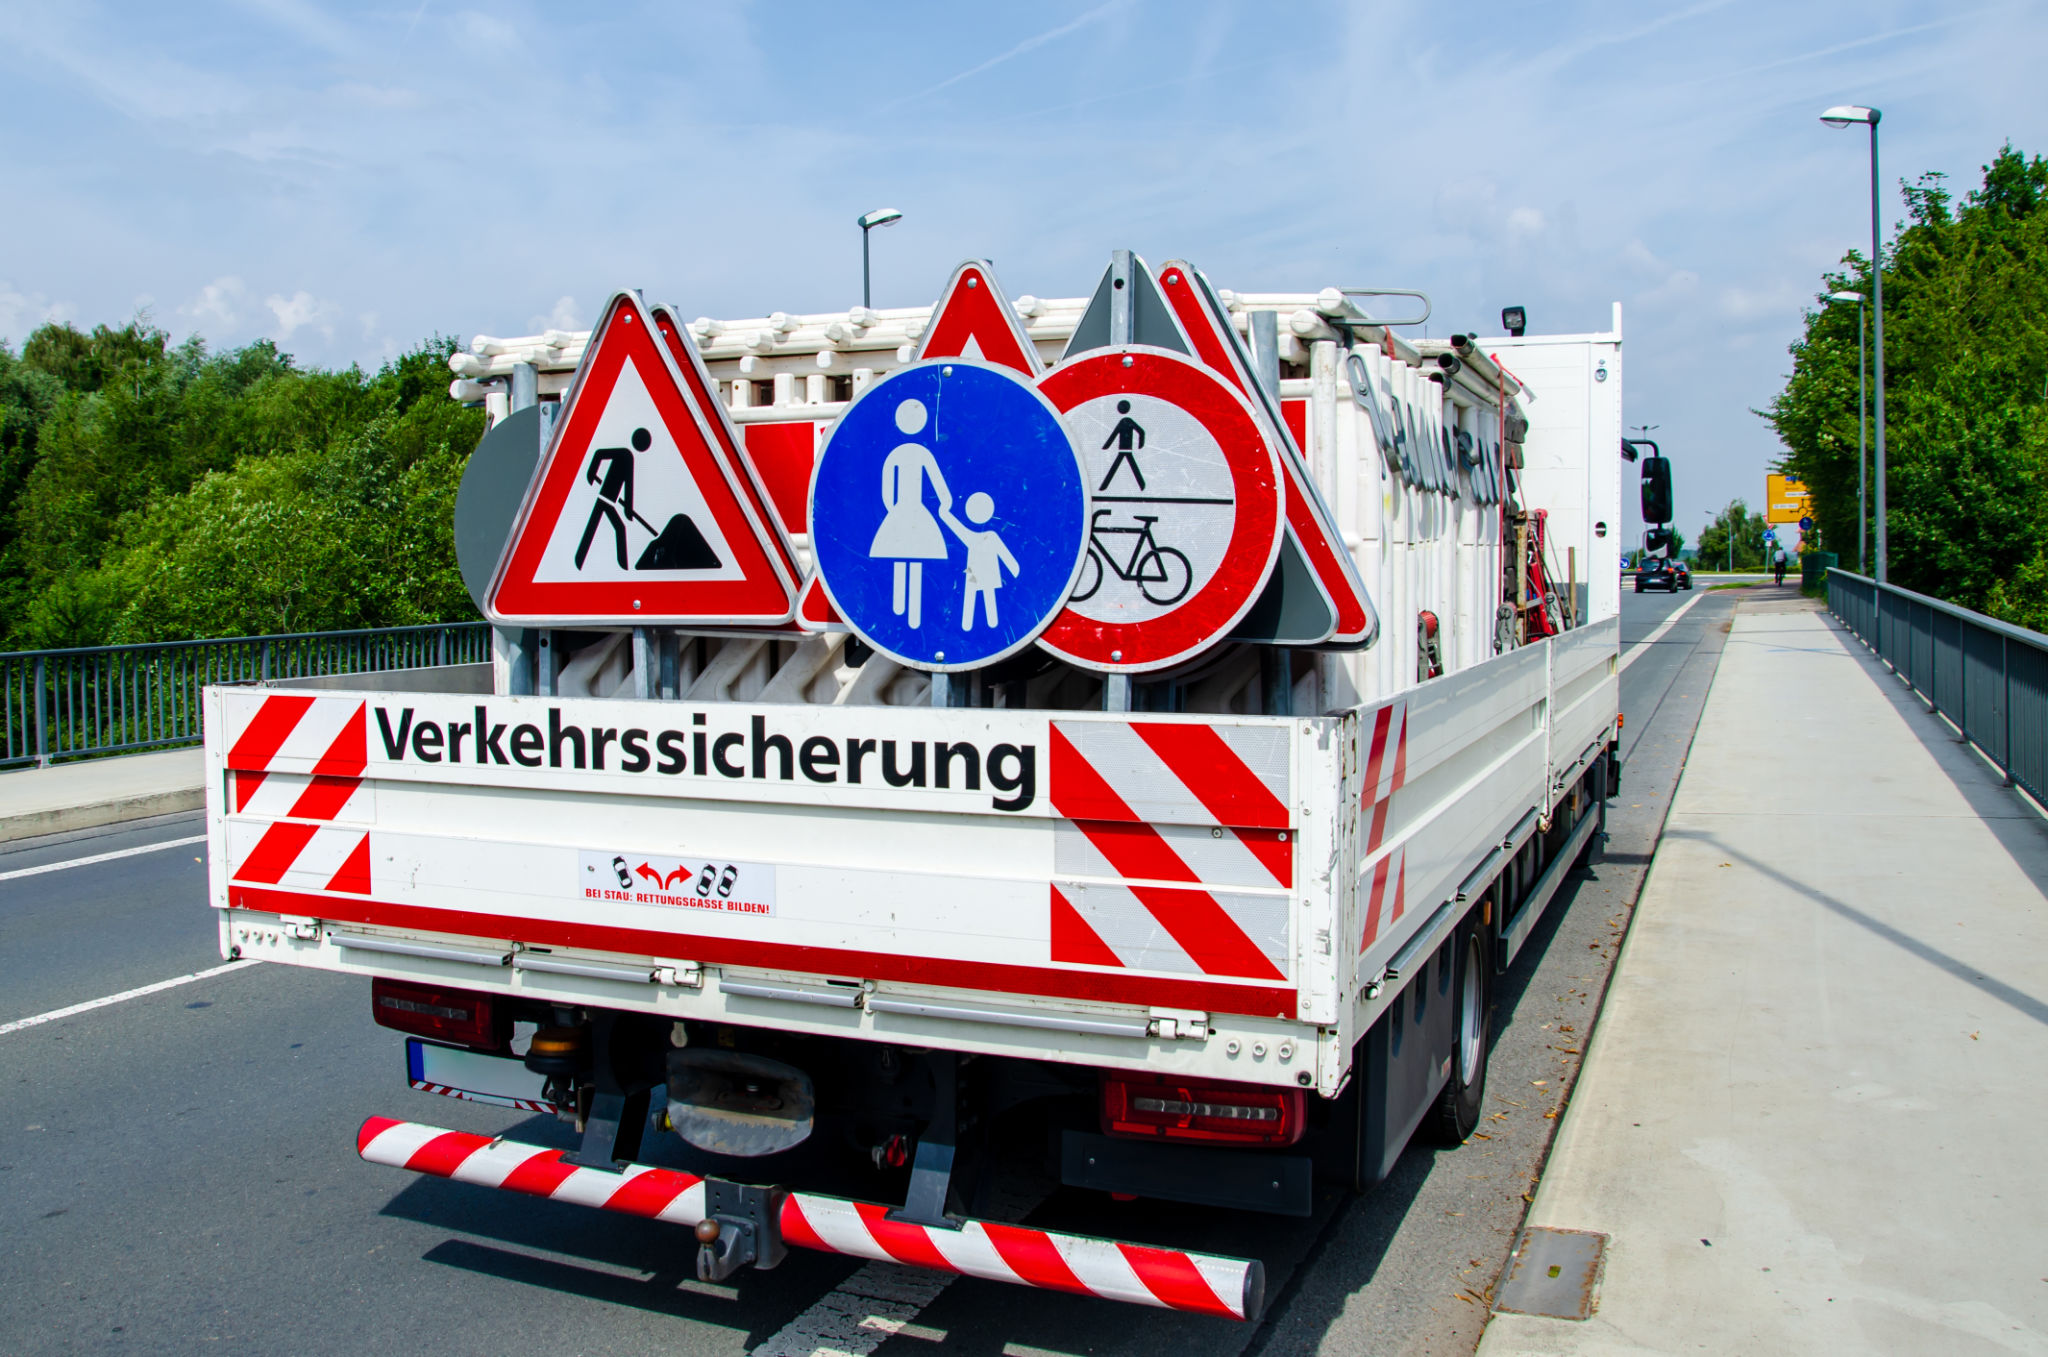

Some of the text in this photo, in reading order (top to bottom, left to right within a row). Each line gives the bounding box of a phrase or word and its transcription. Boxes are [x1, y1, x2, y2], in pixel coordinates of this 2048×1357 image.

[374, 705, 1036, 811] Verkehrssicherung
[585, 888, 770, 914] BEI STAU: RETTUNGSGASSE BILDEN!
